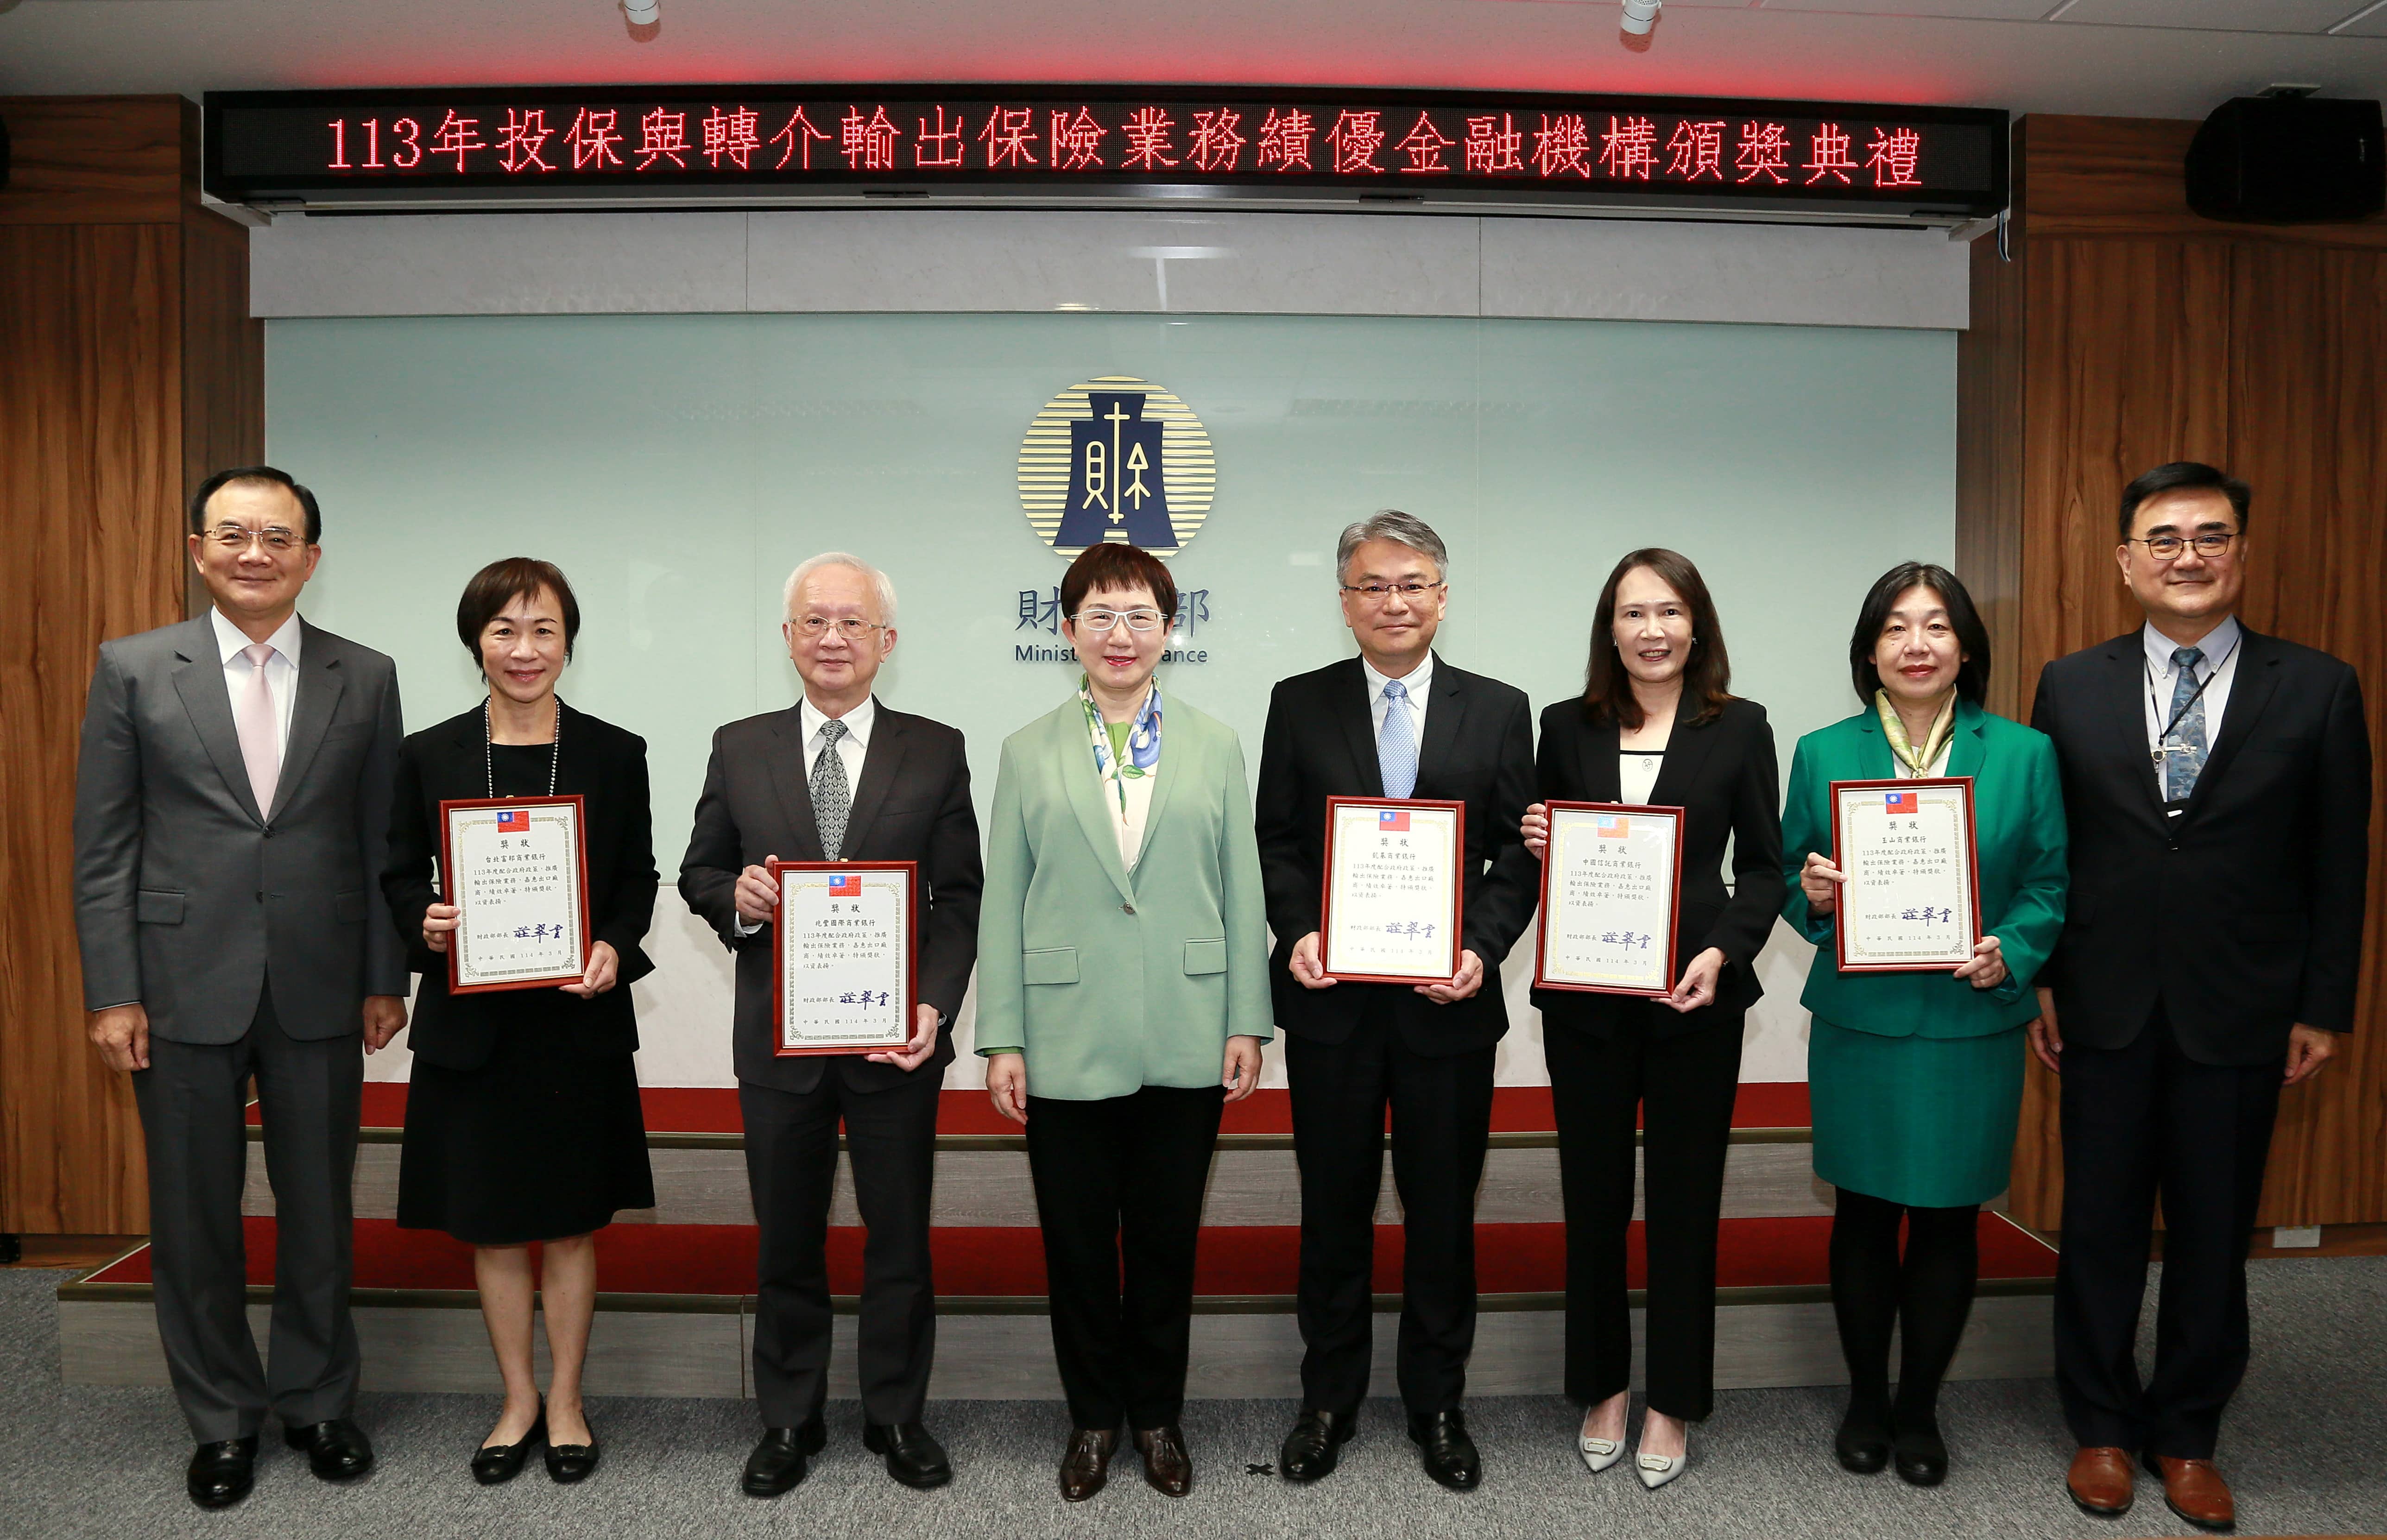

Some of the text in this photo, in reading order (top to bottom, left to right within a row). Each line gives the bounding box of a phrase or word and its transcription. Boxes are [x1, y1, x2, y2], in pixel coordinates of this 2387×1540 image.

[328, 106, 1922, 187] 113年投保與轉介輸出保險業務績優金融機構頒獎典禮
[1015, 586, 1210, 638] 財部
[1015, 644, 1078, 662] Minist
[486, 853, 546, 863] 台北富邦商業銀行
[1583, 858, 1642, 869] 中國信託商業銀行
